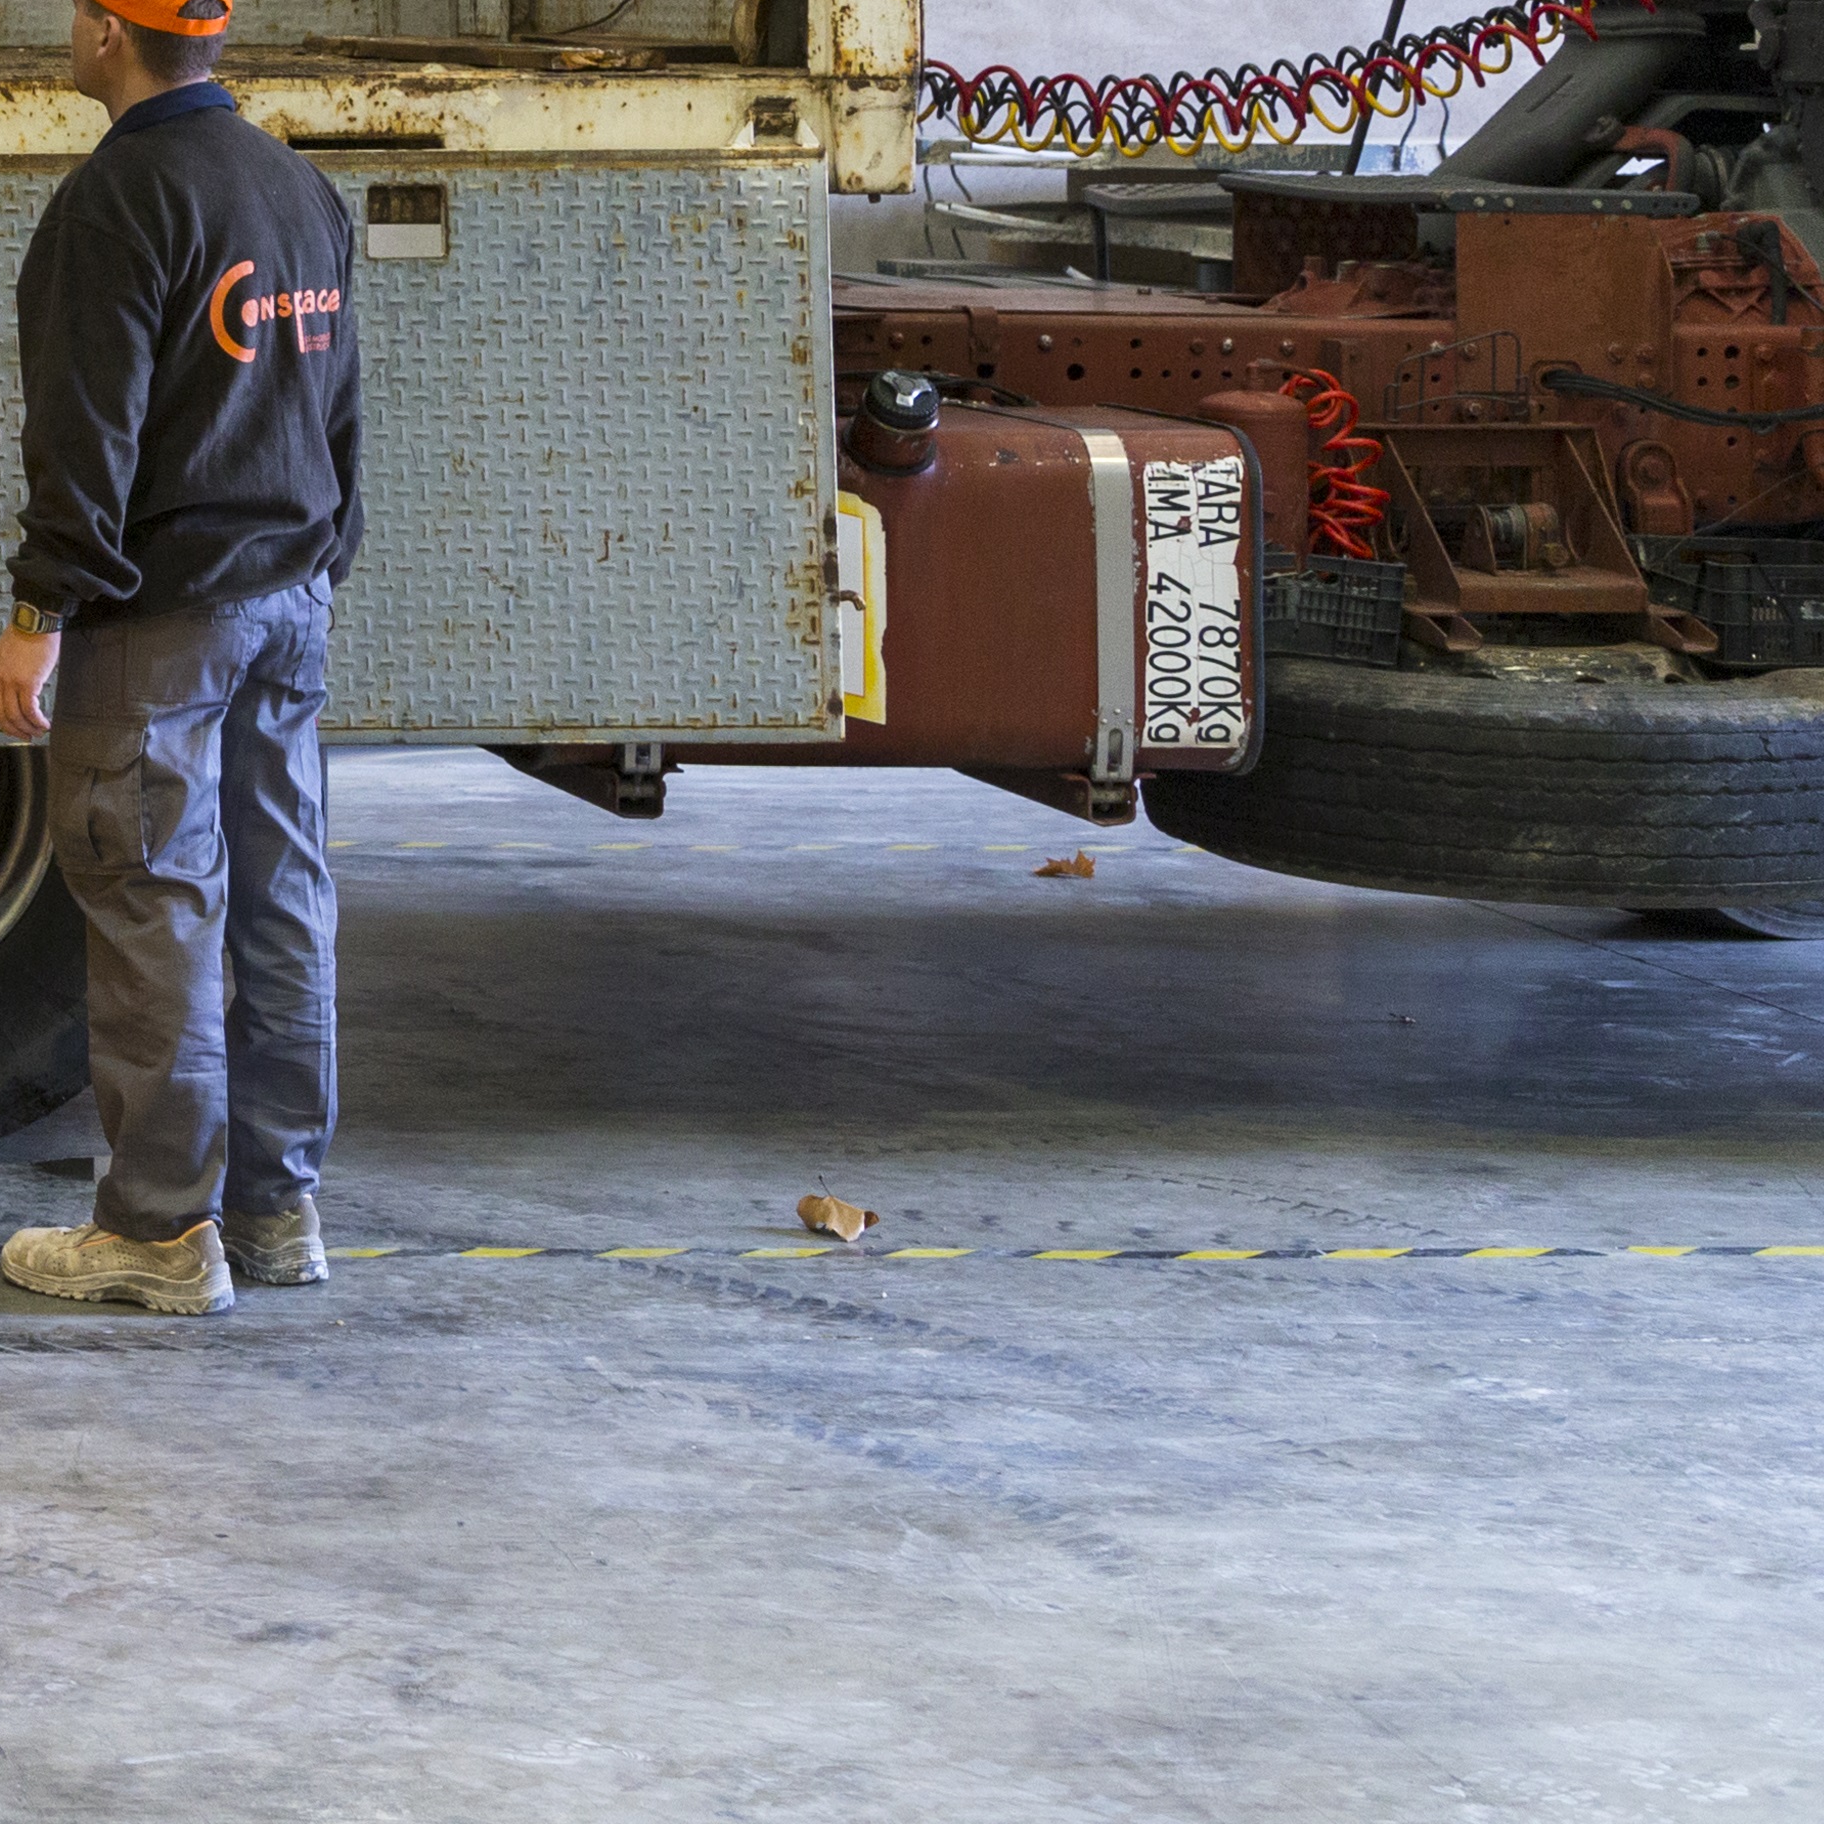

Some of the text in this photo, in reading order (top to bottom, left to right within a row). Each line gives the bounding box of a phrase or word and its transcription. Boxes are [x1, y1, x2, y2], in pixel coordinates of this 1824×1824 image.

[1148, 571, 1192, 743] 42000Kg
[1198, 462, 1242, 743] TARA 7870Kg
